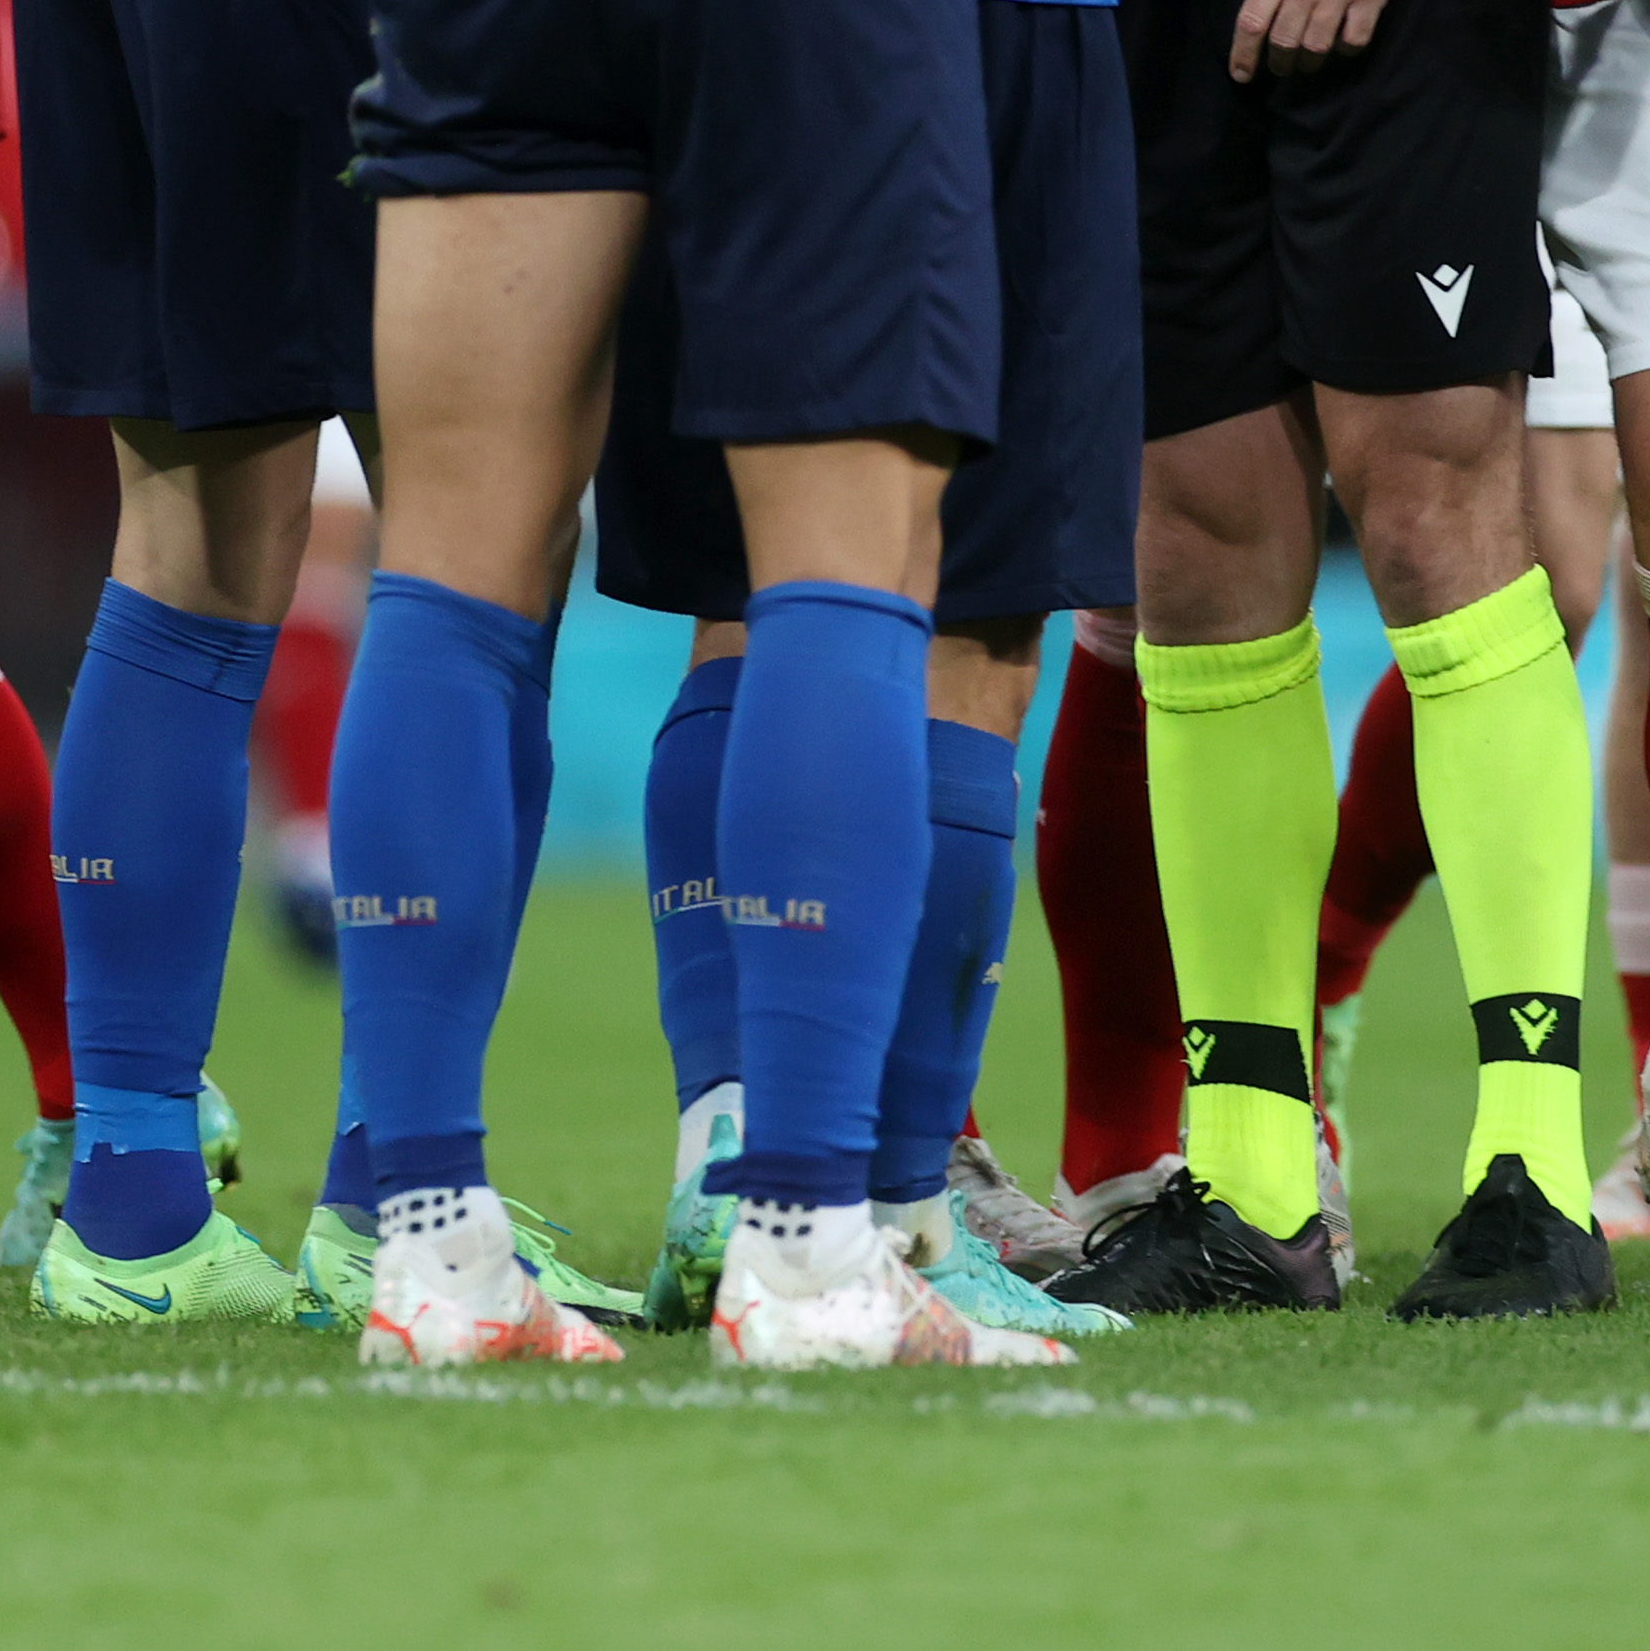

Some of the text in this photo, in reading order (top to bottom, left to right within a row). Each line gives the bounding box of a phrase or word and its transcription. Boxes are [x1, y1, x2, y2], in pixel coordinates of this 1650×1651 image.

[49, 854, 115, 881] ALIA
[331, 896, 437, 921] TALIA
[652, 877, 727, 918] ITAL
[721, 895, 826, 926] TALIA
